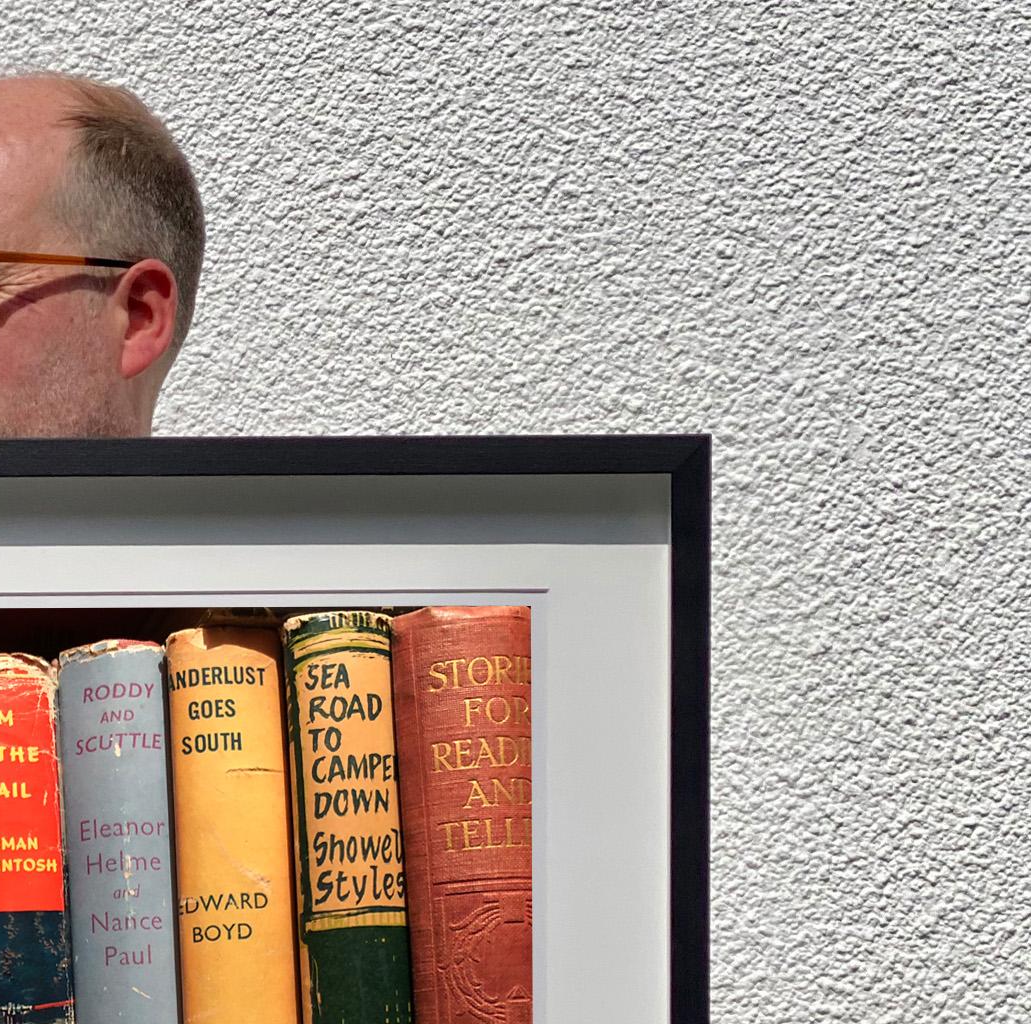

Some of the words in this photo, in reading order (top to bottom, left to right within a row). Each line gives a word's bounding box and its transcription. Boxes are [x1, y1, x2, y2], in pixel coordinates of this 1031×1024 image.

[304, 662, 351, 691] SEA
[83, 682, 155, 705] RODDY
[100, 709, 136, 725] AND
[188, 698, 237, 721] GOES
[308, 693, 383, 724] ROAD
[463, 696, 531, 728] FOR
[75, 732, 162, 756] SCUTTLE
[181, 732, 243, 756] SOUTH
[308, 726, 343, 753] TO
[314, 787, 390, 820] DOWN
[80, 818, 166, 843] Eleanor
[86, 850, 162, 876] Helme
[113, 883, 141, 900] and
[91, 911, 164, 935] Nance
[192, 922, 253, 944] BOYD
[104, 943, 153, 967] Paul
